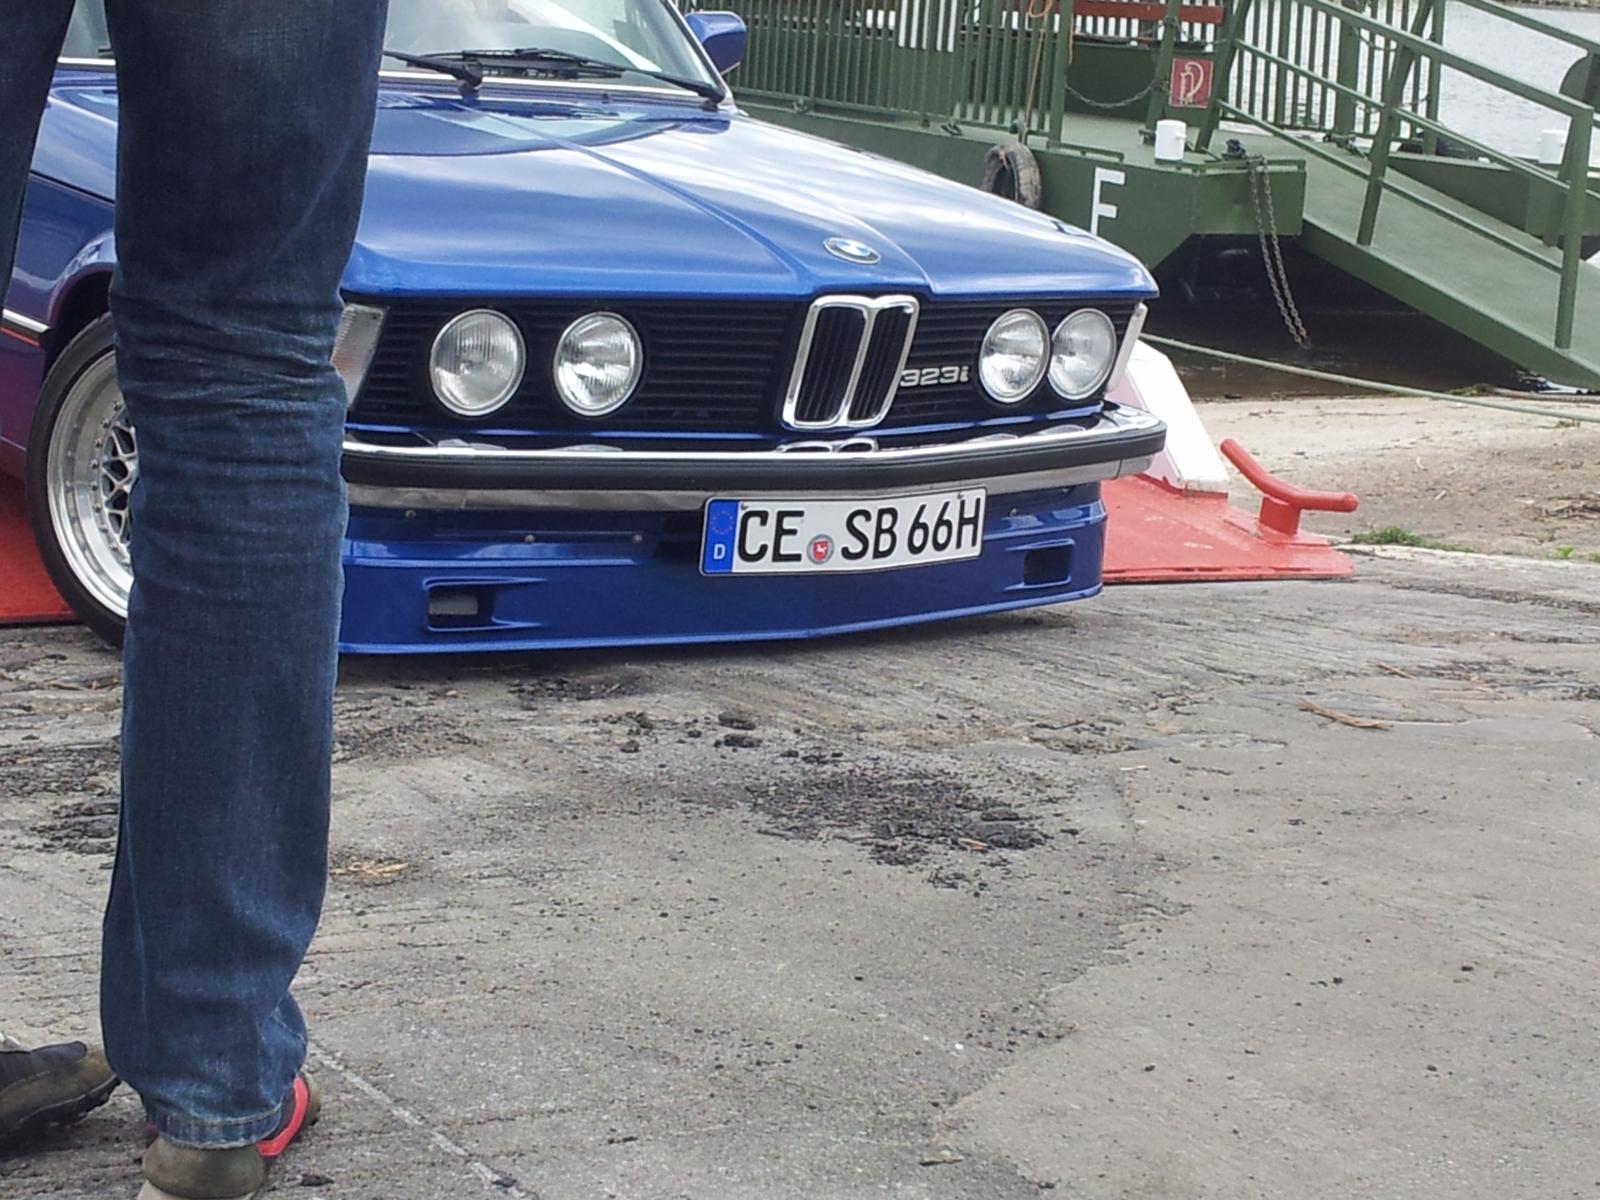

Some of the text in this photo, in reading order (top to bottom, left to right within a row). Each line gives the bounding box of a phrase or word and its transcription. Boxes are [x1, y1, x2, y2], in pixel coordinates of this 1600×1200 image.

[900, 366, 969, 387] 323i
[737, 497, 982, 562] CE SB 66H
[713, 544, 727, 560] D
